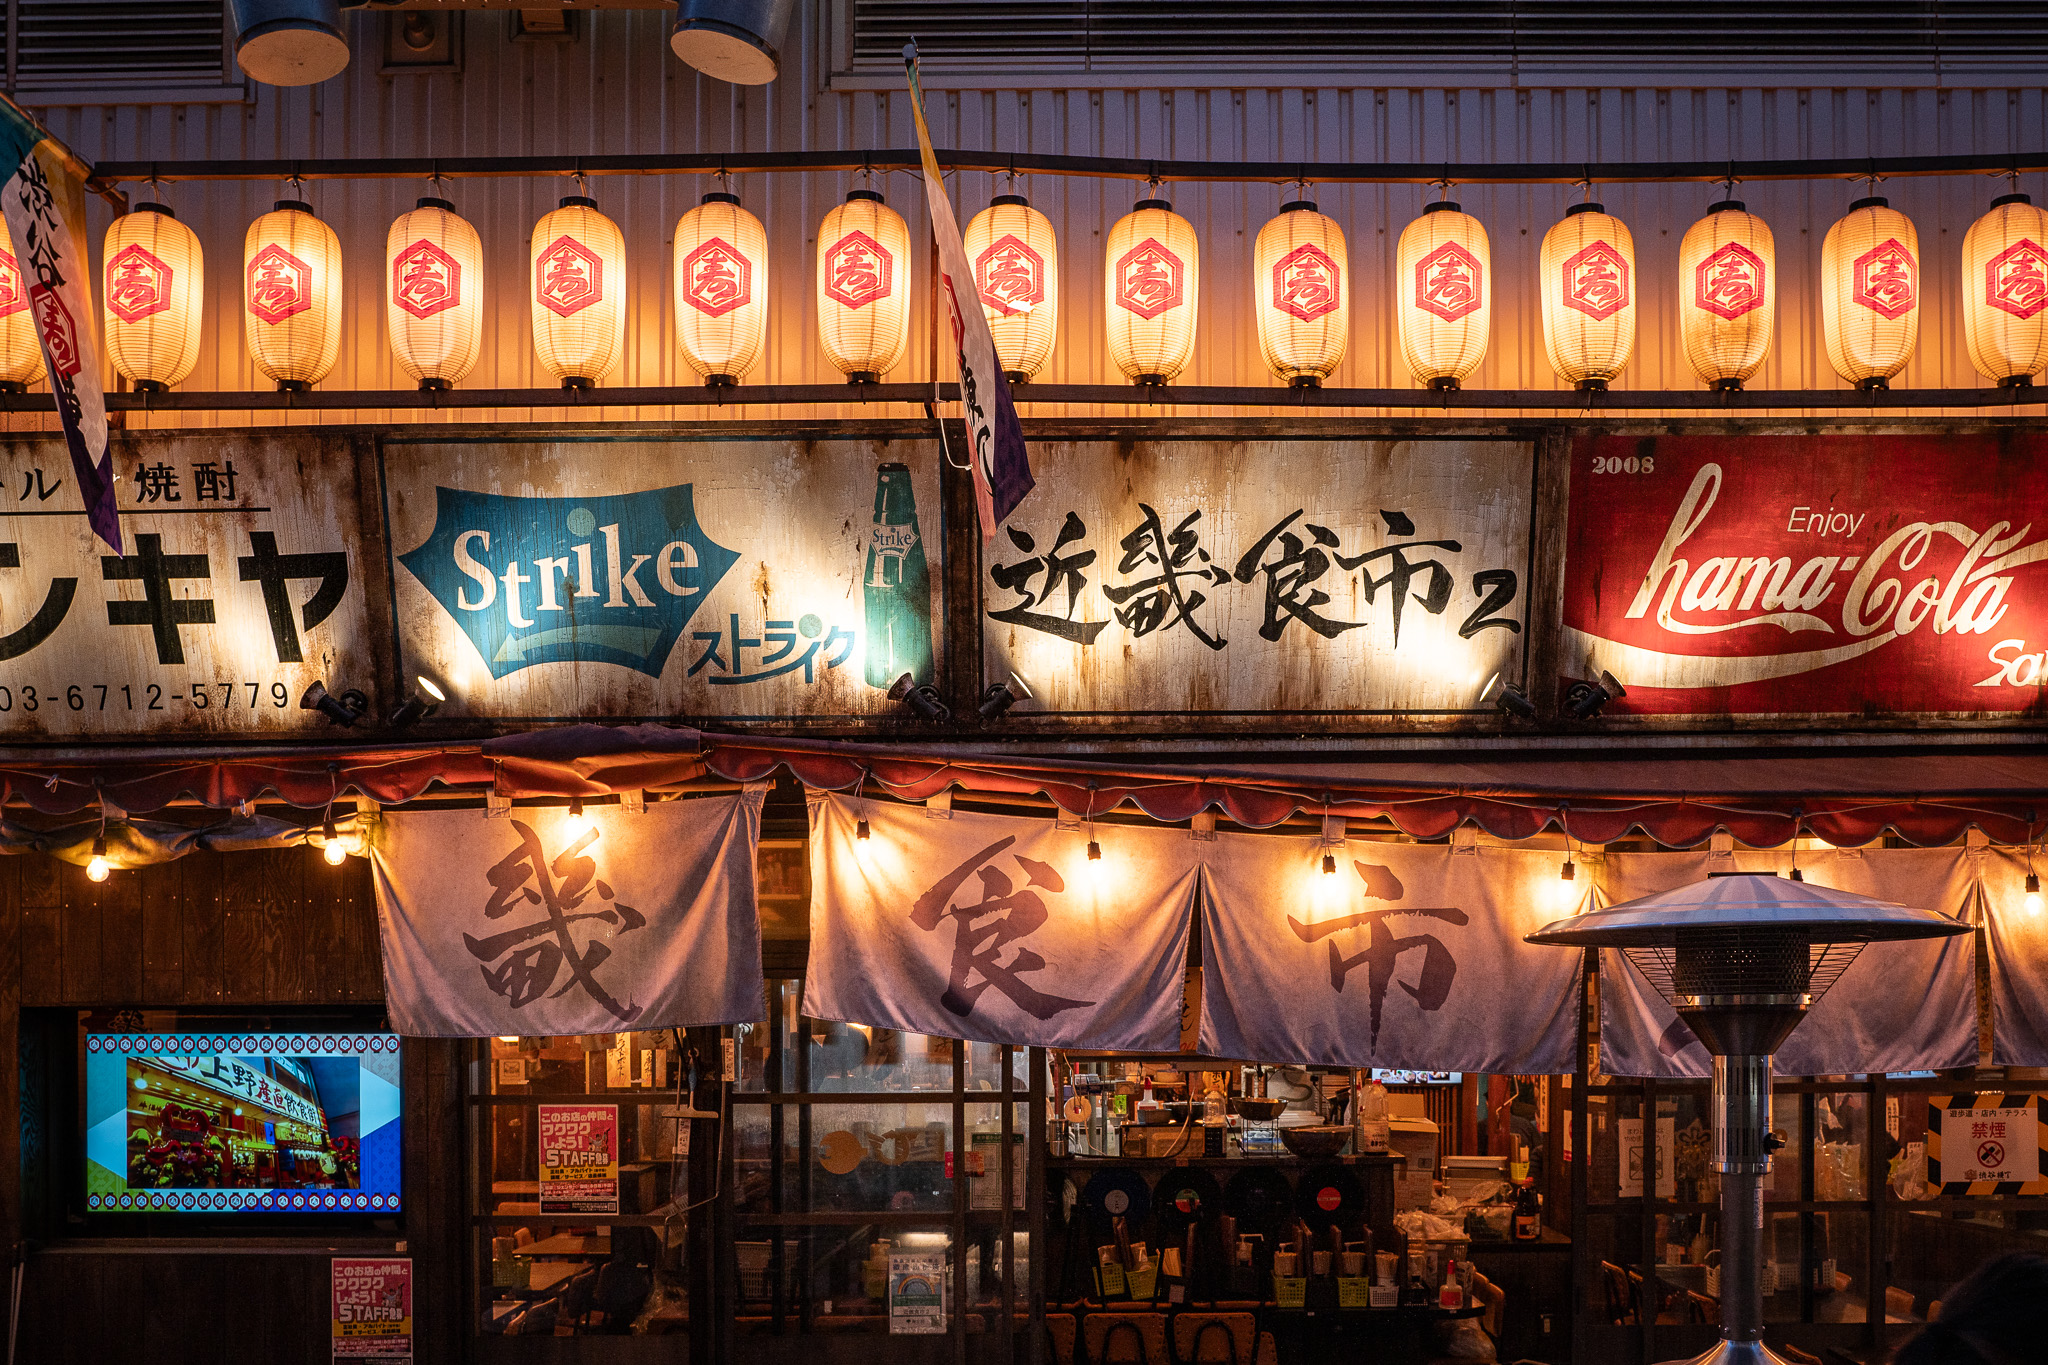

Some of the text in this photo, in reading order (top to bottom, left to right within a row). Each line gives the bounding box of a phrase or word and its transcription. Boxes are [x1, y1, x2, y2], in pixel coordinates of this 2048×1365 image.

[1592, 456, 1655, 474] 2008
[134, 460, 239, 503] 焼酎
[1787, 507, 1865, 538] Enjoy
[873, 527, 911, 546] Strike
[453, 507, 700, 629] Strike
[688, 612, 855, 685] ストライク
[1972, 638, 2048, 687] Sa
[0, 682, 288, 711] 03-6712-5779
[463, 820, 1468, 1056] 畿 食 市
[541, 1111, 614, 1123] このお店の仲間と
[1949, 1109, 2028, 1118] 遊歩道・店内・テラス
[541, 1123, 591, 1136] ワクワク
[1971, 1122, 2007, 1139] 禁煙
[543, 1136, 583, 1149] しよう！
[334, 1265, 408, 1277] このお店の仲間と
[334, 1277, 384, 1290] ワクワク
[336, 1290, 377, 1304] しよう！
